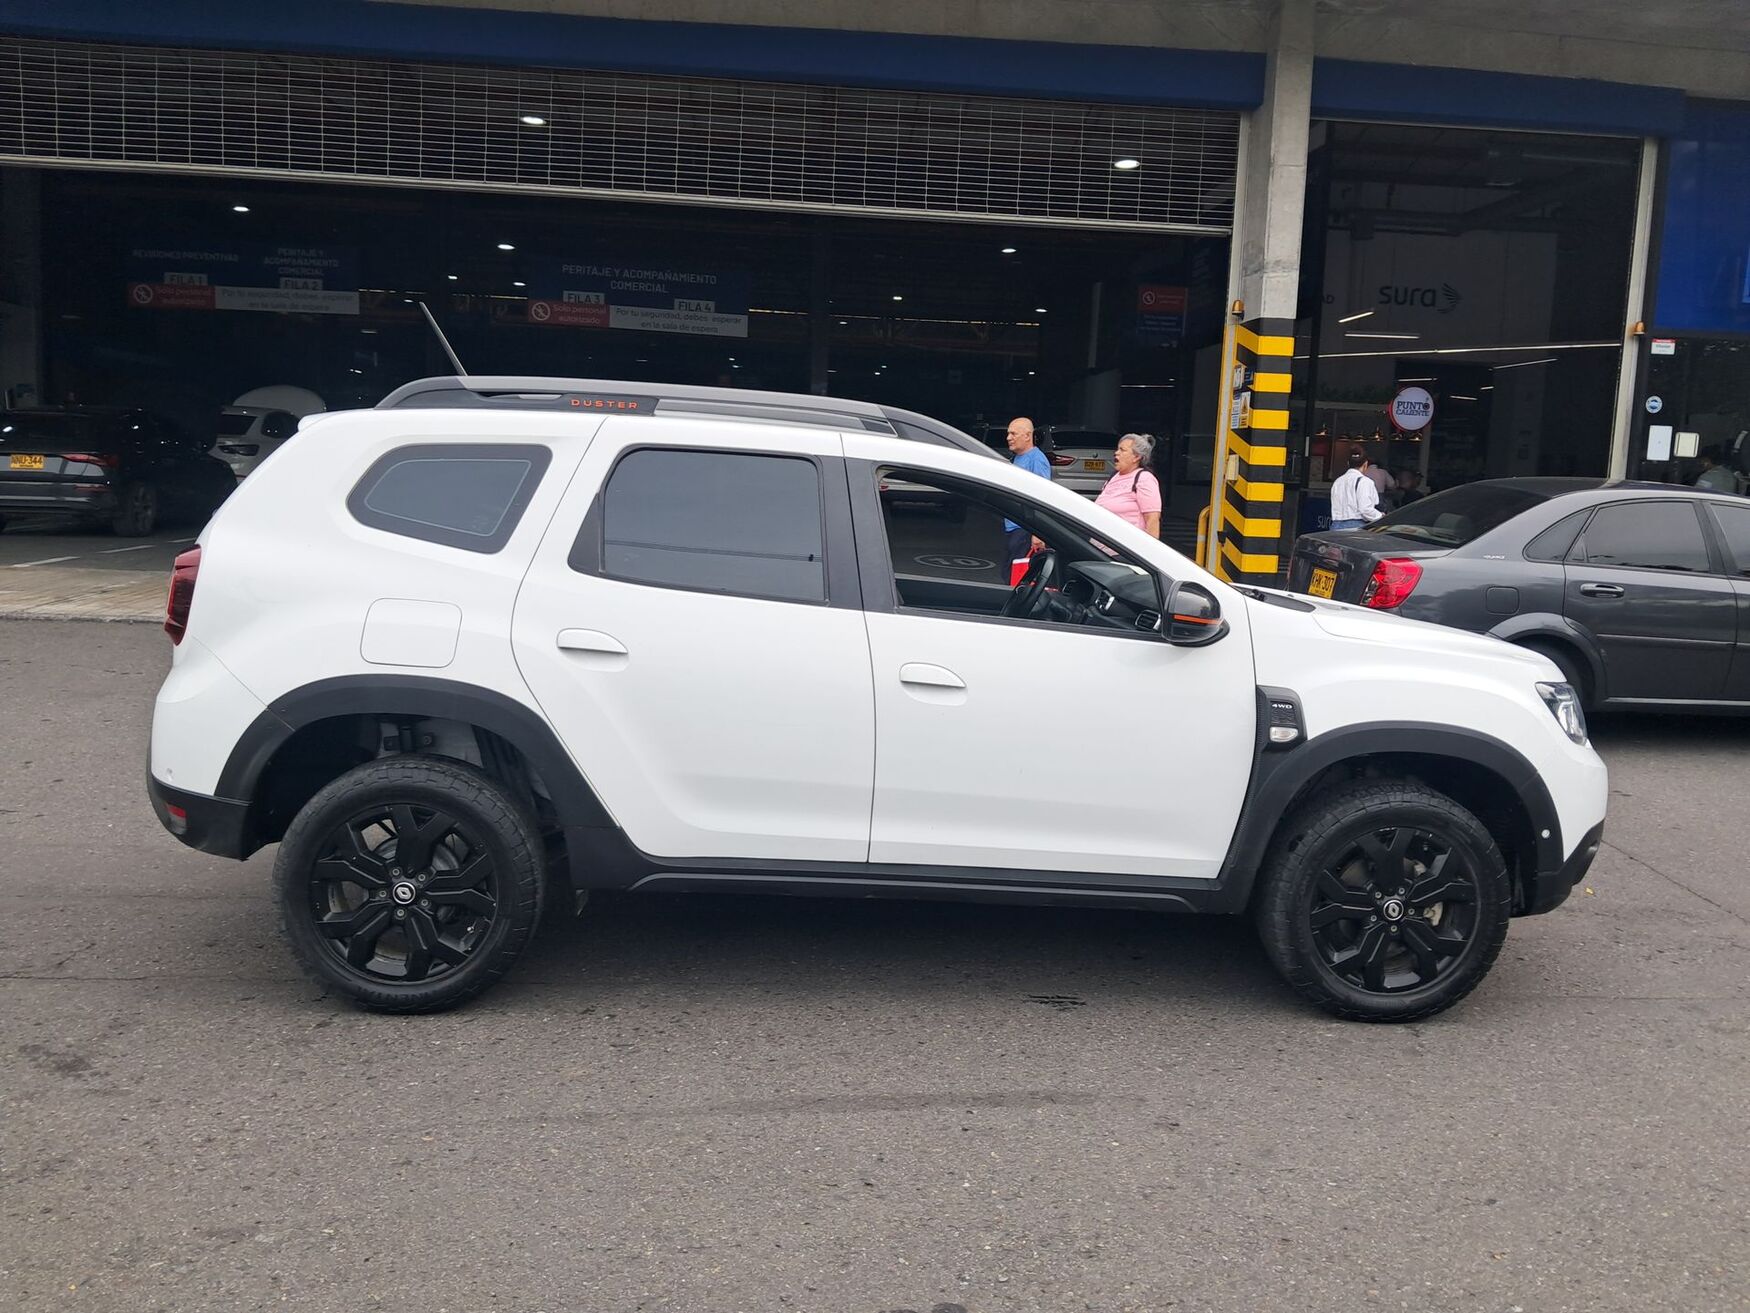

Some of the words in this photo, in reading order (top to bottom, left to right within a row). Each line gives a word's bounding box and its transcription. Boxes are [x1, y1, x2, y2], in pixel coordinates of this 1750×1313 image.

[169, 274, 196, 286] FILA
[562, 263, 612, 278] PERITAJE
[612, 267, 621, 278] Y
[622, 267, 718, 285] ACOMPAÑAMIENTO
[284, 279, 309, 290] FILA
[311, 280, 319, 290] 2
[610, 280, 669, 294] COMERCIAL
[567, 293, 592, 304] FILA
[593, 294, 601, 304] 3
[1378, 285, 1437, 308] sura
[678, 301, 702, 312] FILA
[704, 302, 712, 312] 4
[616, 307, 630, 316] Por
[683, 312, 708, 322] debes
[662, 321, 677, 330] sala
[679, 322, 690, 331] de
[691, 325, 719, 334] espera
[571, 399, 638, 409] DUSTER
[1397, 400, 1430, 411] PUNTO
